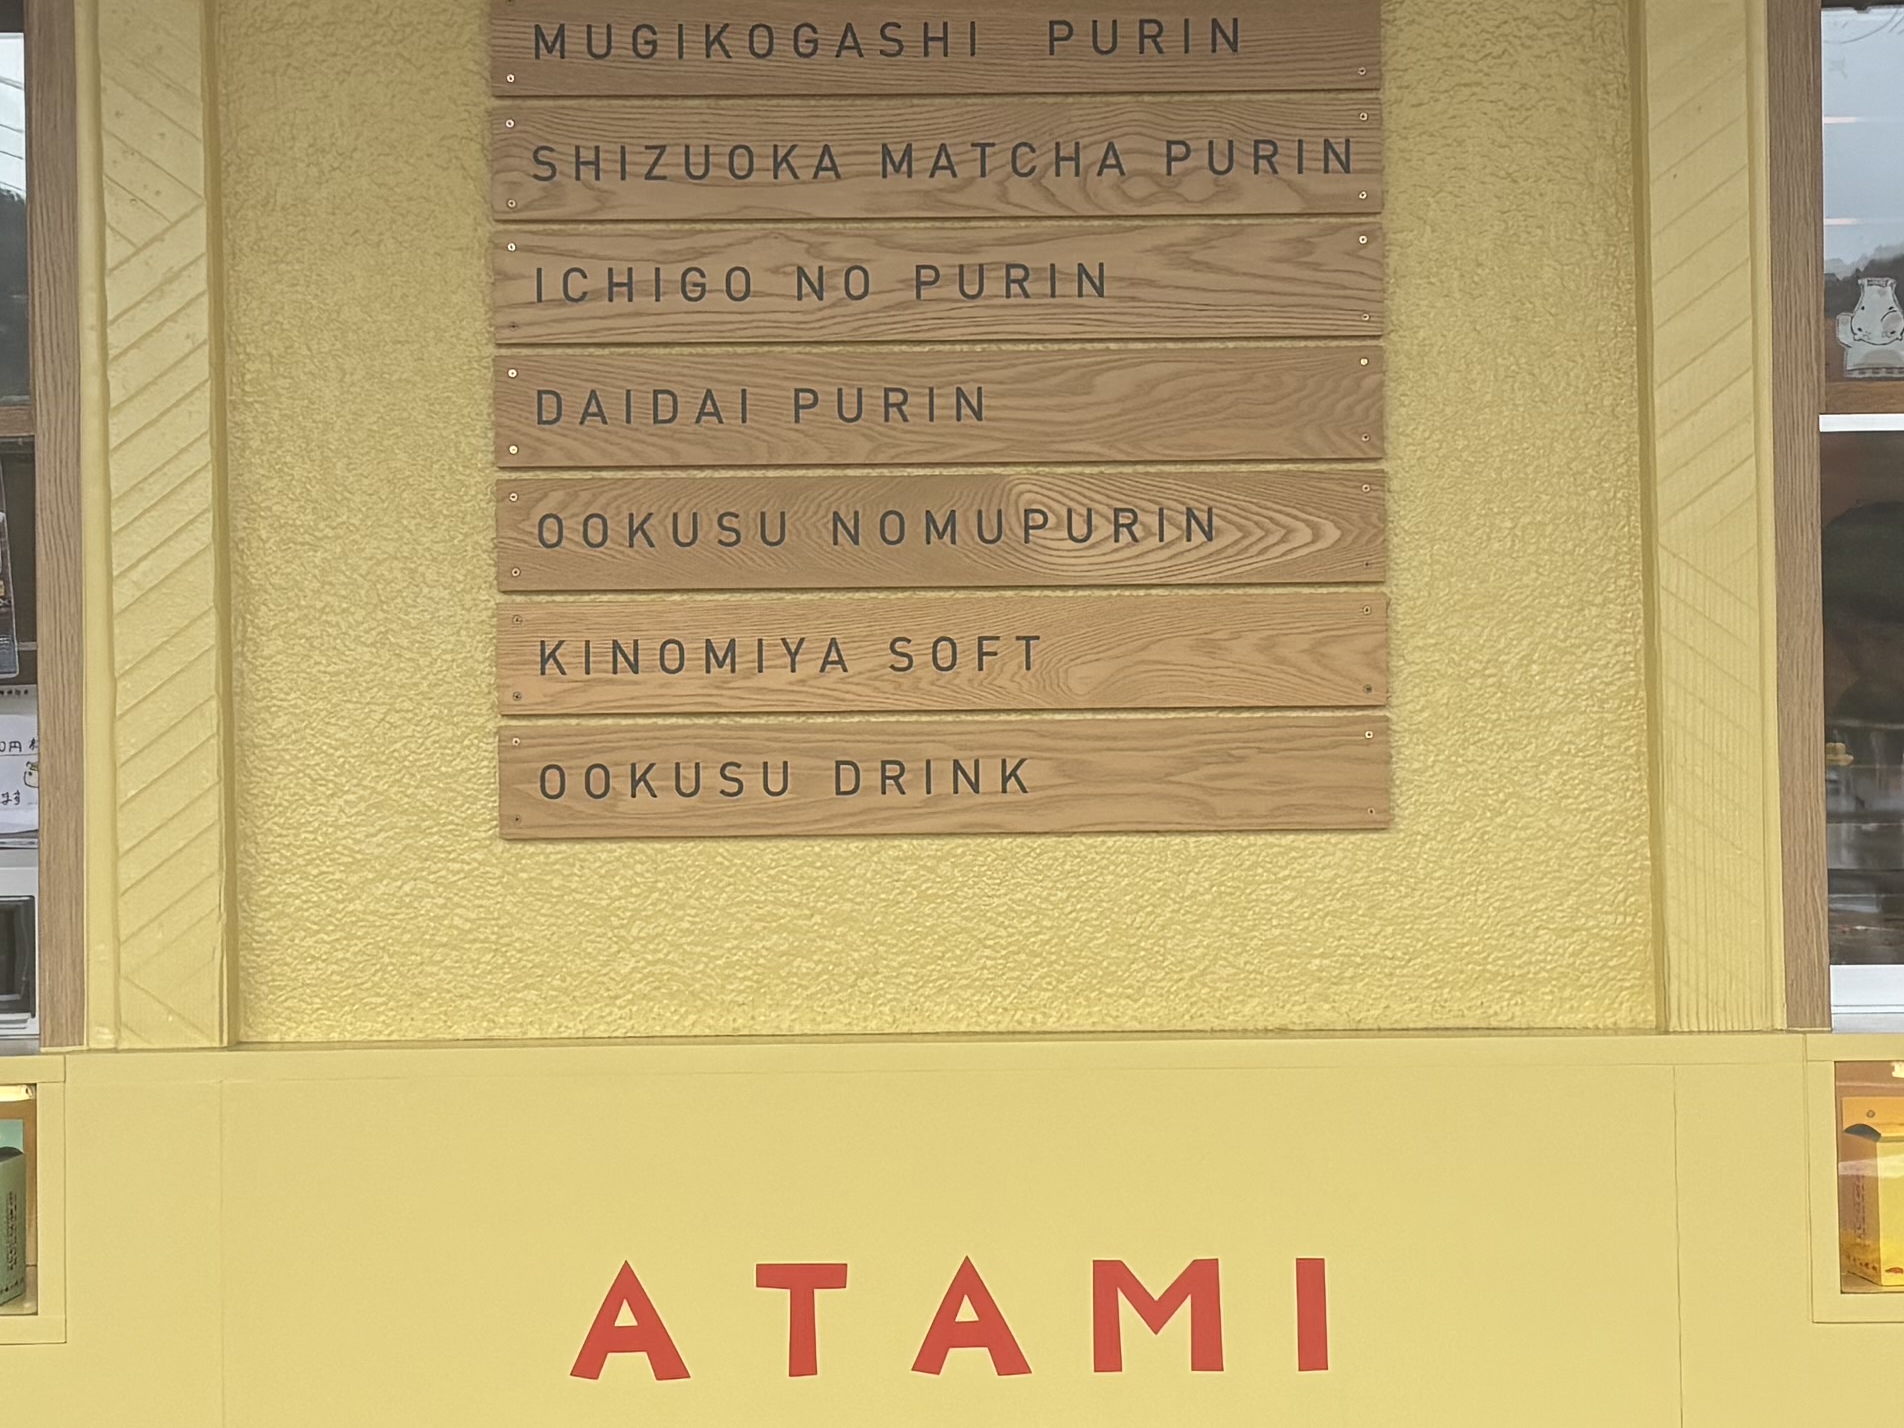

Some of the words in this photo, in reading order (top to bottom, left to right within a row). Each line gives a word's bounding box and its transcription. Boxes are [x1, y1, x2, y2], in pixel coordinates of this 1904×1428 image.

[532, 20, 980, 62] MUGIKOGASHI
[1046, 17, 1242, 57] PURIN
[531, 143, 843, 183] SHIZUOKA
[879, 140, 1127, 180] MATCHA
[1164, 137, 1354, 176] PURIN
[534, 265, 755, 304] ICHIGO
[795, 264, 872, 303] NO
[914, 262, 1109, 301] PURIN
[536, 388, 751, 427] DAIDAI
[793, 386, 986, 425] PURIN
[537, 510, 790, 550] OOKUSU
[831, 506, 1218, 547] NOMUPURIN
[539, 636, 851, 678] KINOMIYA
[888, 634, 1045, 675] SOFT
[539, 759, 793, 801] OOKUSU
[833, 756, 1033, 798] DRINK
[569, 1255, 1330, 1382] ATAMI
